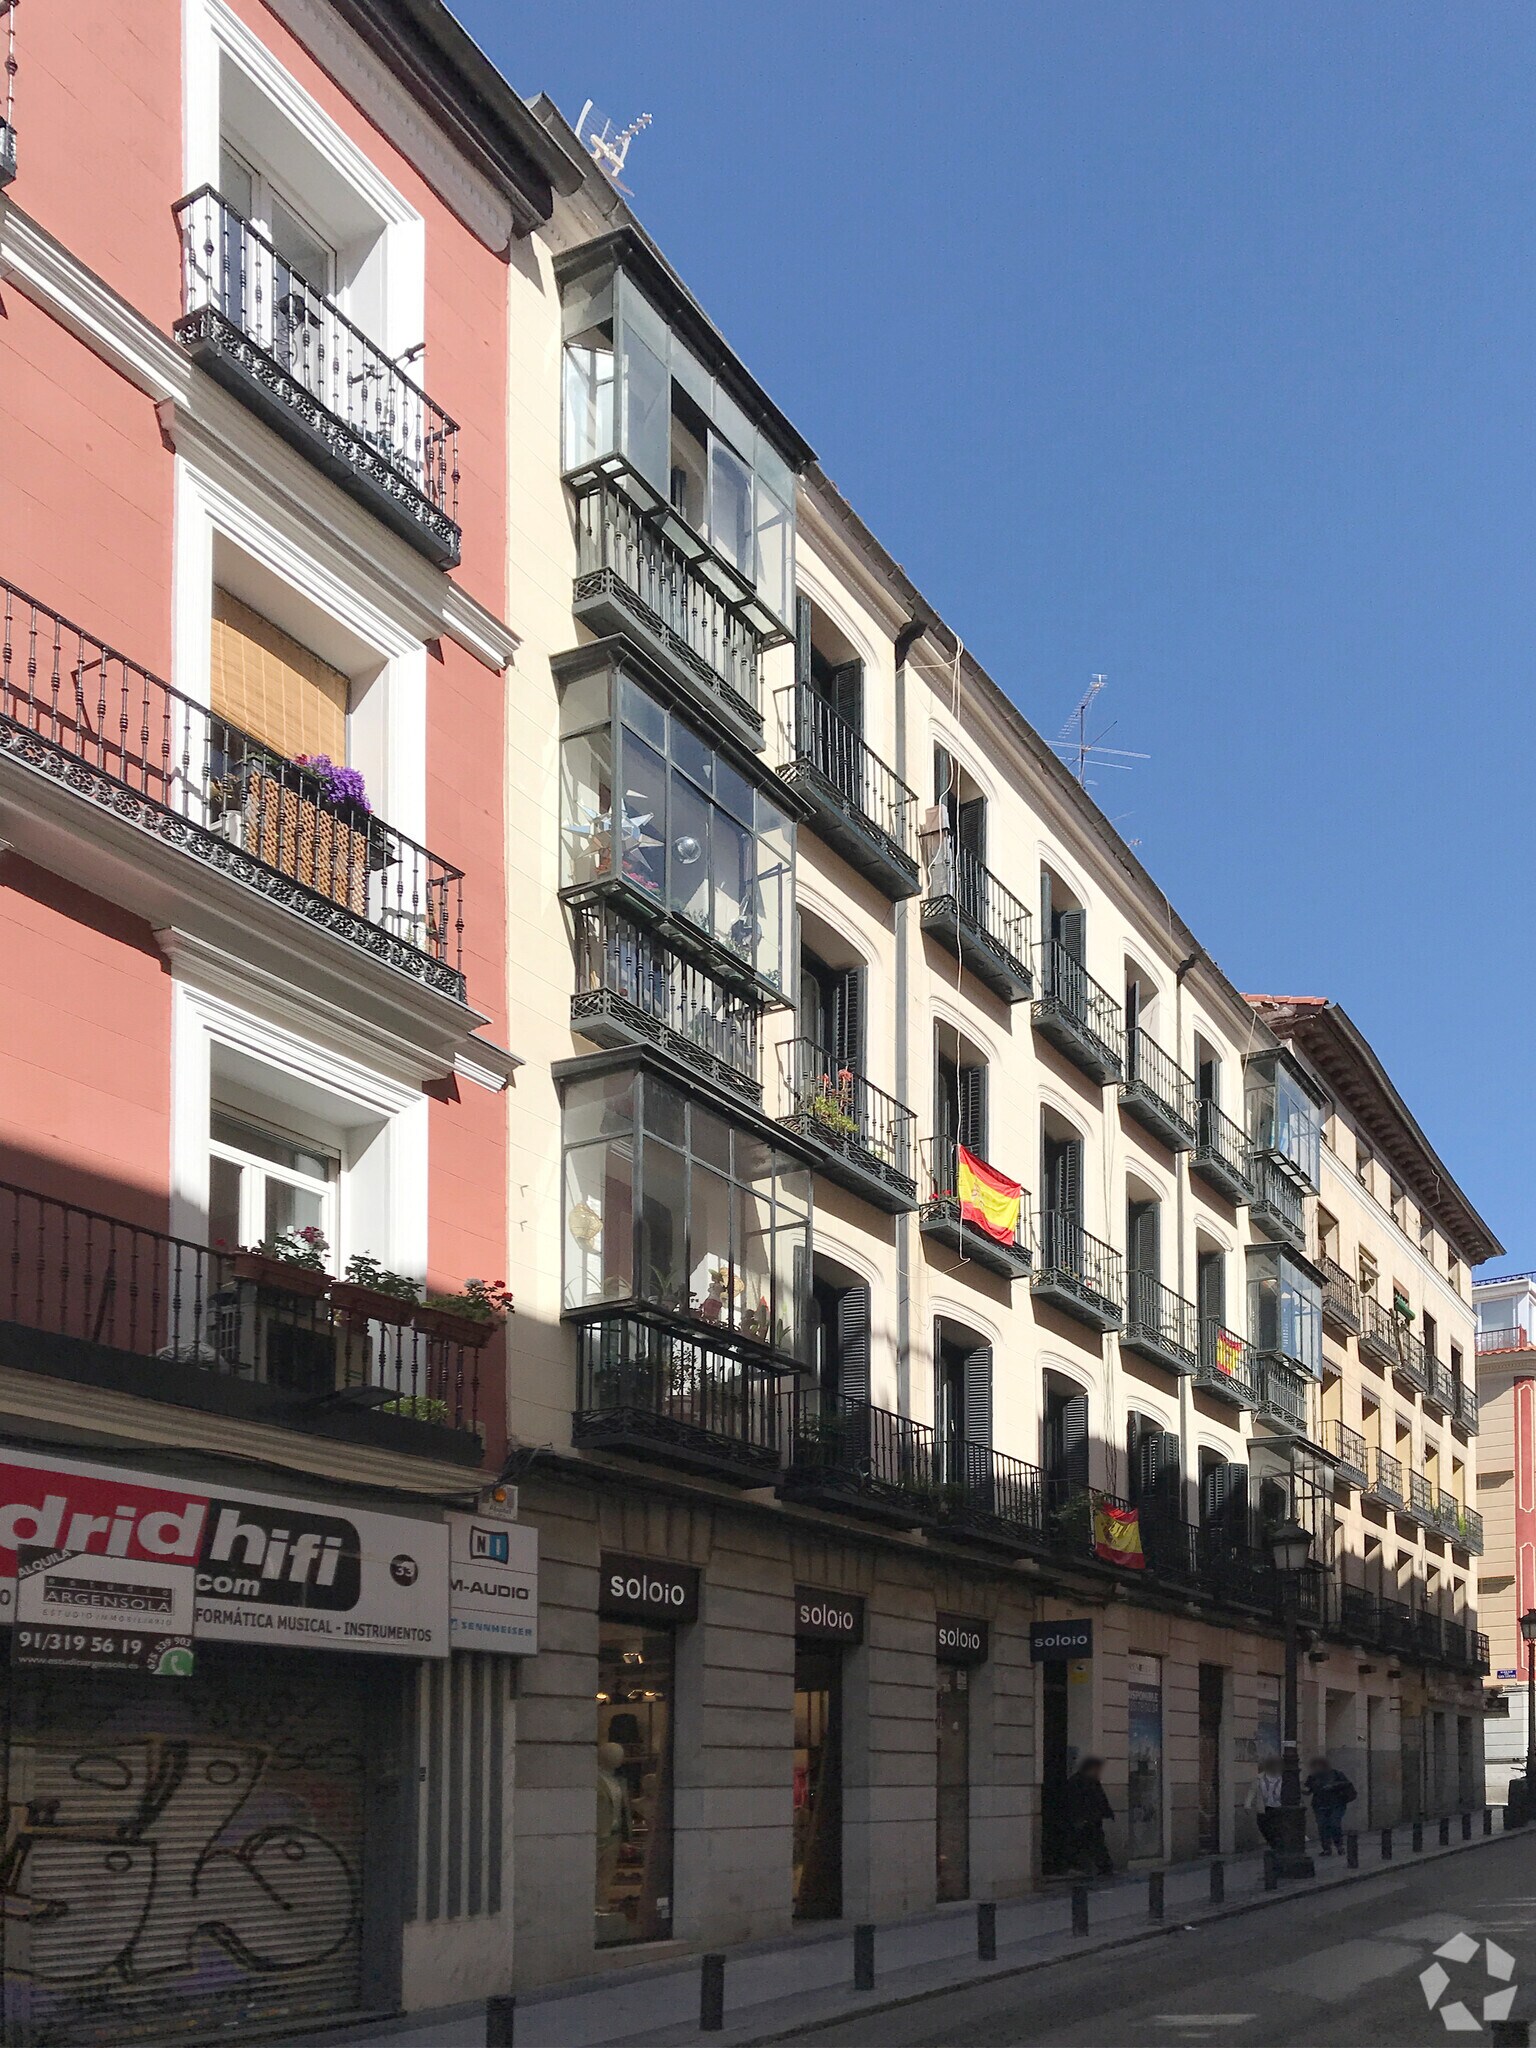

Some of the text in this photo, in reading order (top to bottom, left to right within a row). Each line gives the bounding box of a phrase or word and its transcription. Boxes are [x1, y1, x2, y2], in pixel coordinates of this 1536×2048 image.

[18, 1549, 72, 1578] ALQUILA
[394, 1565, 414, 1577] 33
[450, 1579, 529, 1600] M-AUDIO
[610, 1574, 685, 1606] soloio
[46, 1591, 170, 1612] ARGENSOLA
[42, 1608, 93, 1619] ESTUDIO
[800, 1604, 853, 1630] soloio
[277, 1615, 332, 1634] MUSICAL
[344, 1621, 432, 1642] INSTRUMENTOS
[461, 1621, 532, 1636] SENNHEISER
[938, 1627, 980, 1650] soloio
[19, 1632, 142, 1654] 91/319 56 19
[174, 1636, 192, 1647] 903
[1034, 1634, 1088, 1647] soloio
